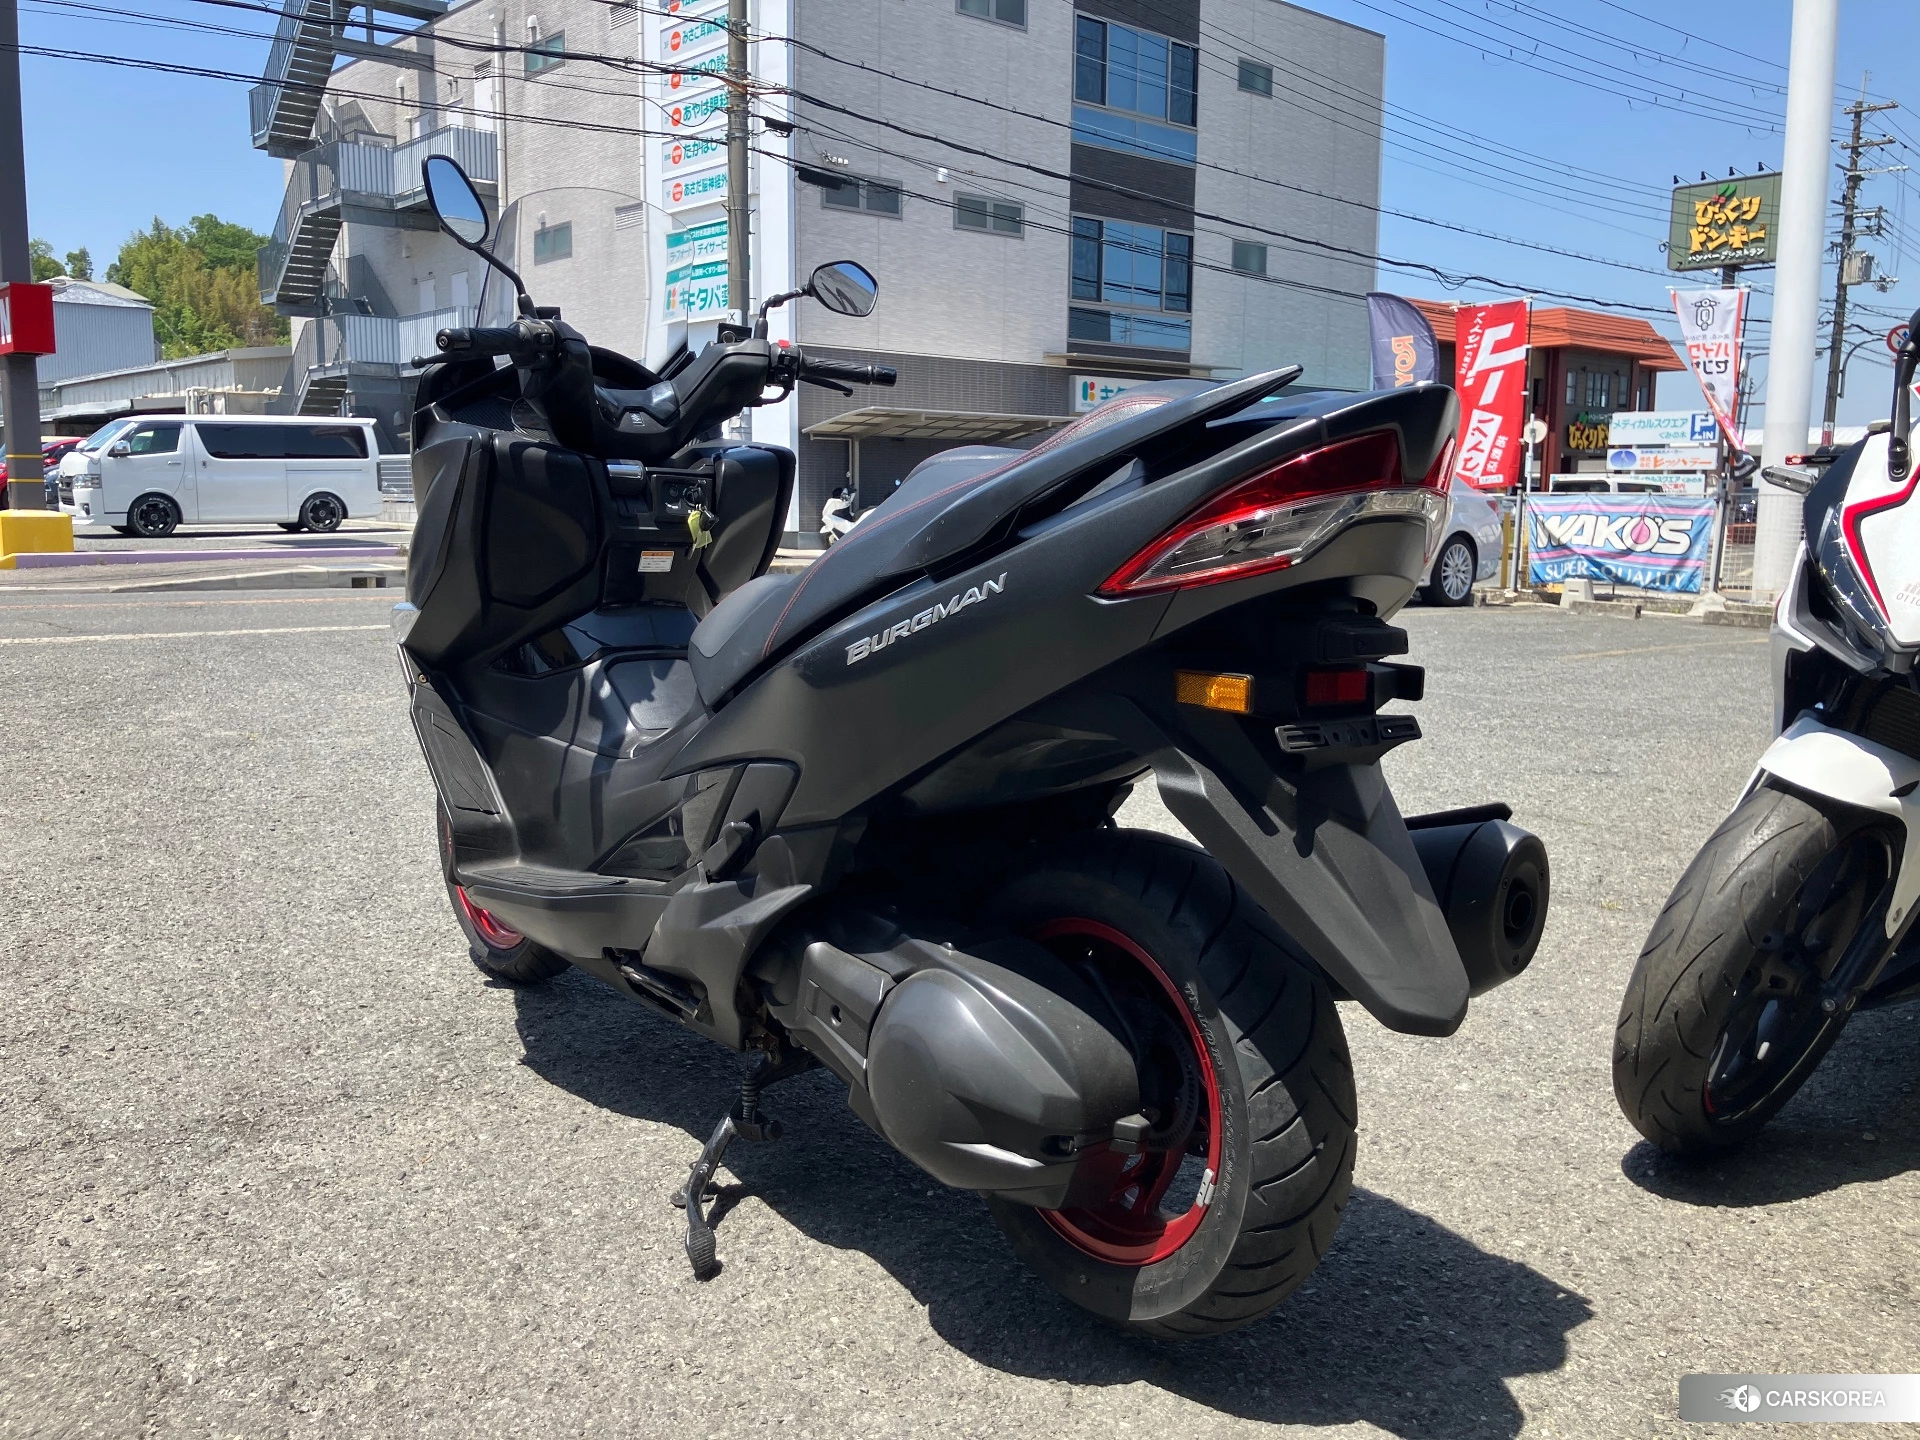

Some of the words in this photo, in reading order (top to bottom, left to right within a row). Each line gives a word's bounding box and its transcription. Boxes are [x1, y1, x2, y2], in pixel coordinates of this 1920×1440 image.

[1694, 195, 1762, 226] びっくり
[1689, 224, 1766, 254] ドンキー
[1613, 417, 1689, 430] メディカルスクエア
[1702, 431, 1714, 440] IN
[1536, 513, 1694, 556] WAKO'S
[844, 571, 1008, 666] BURGMAN
